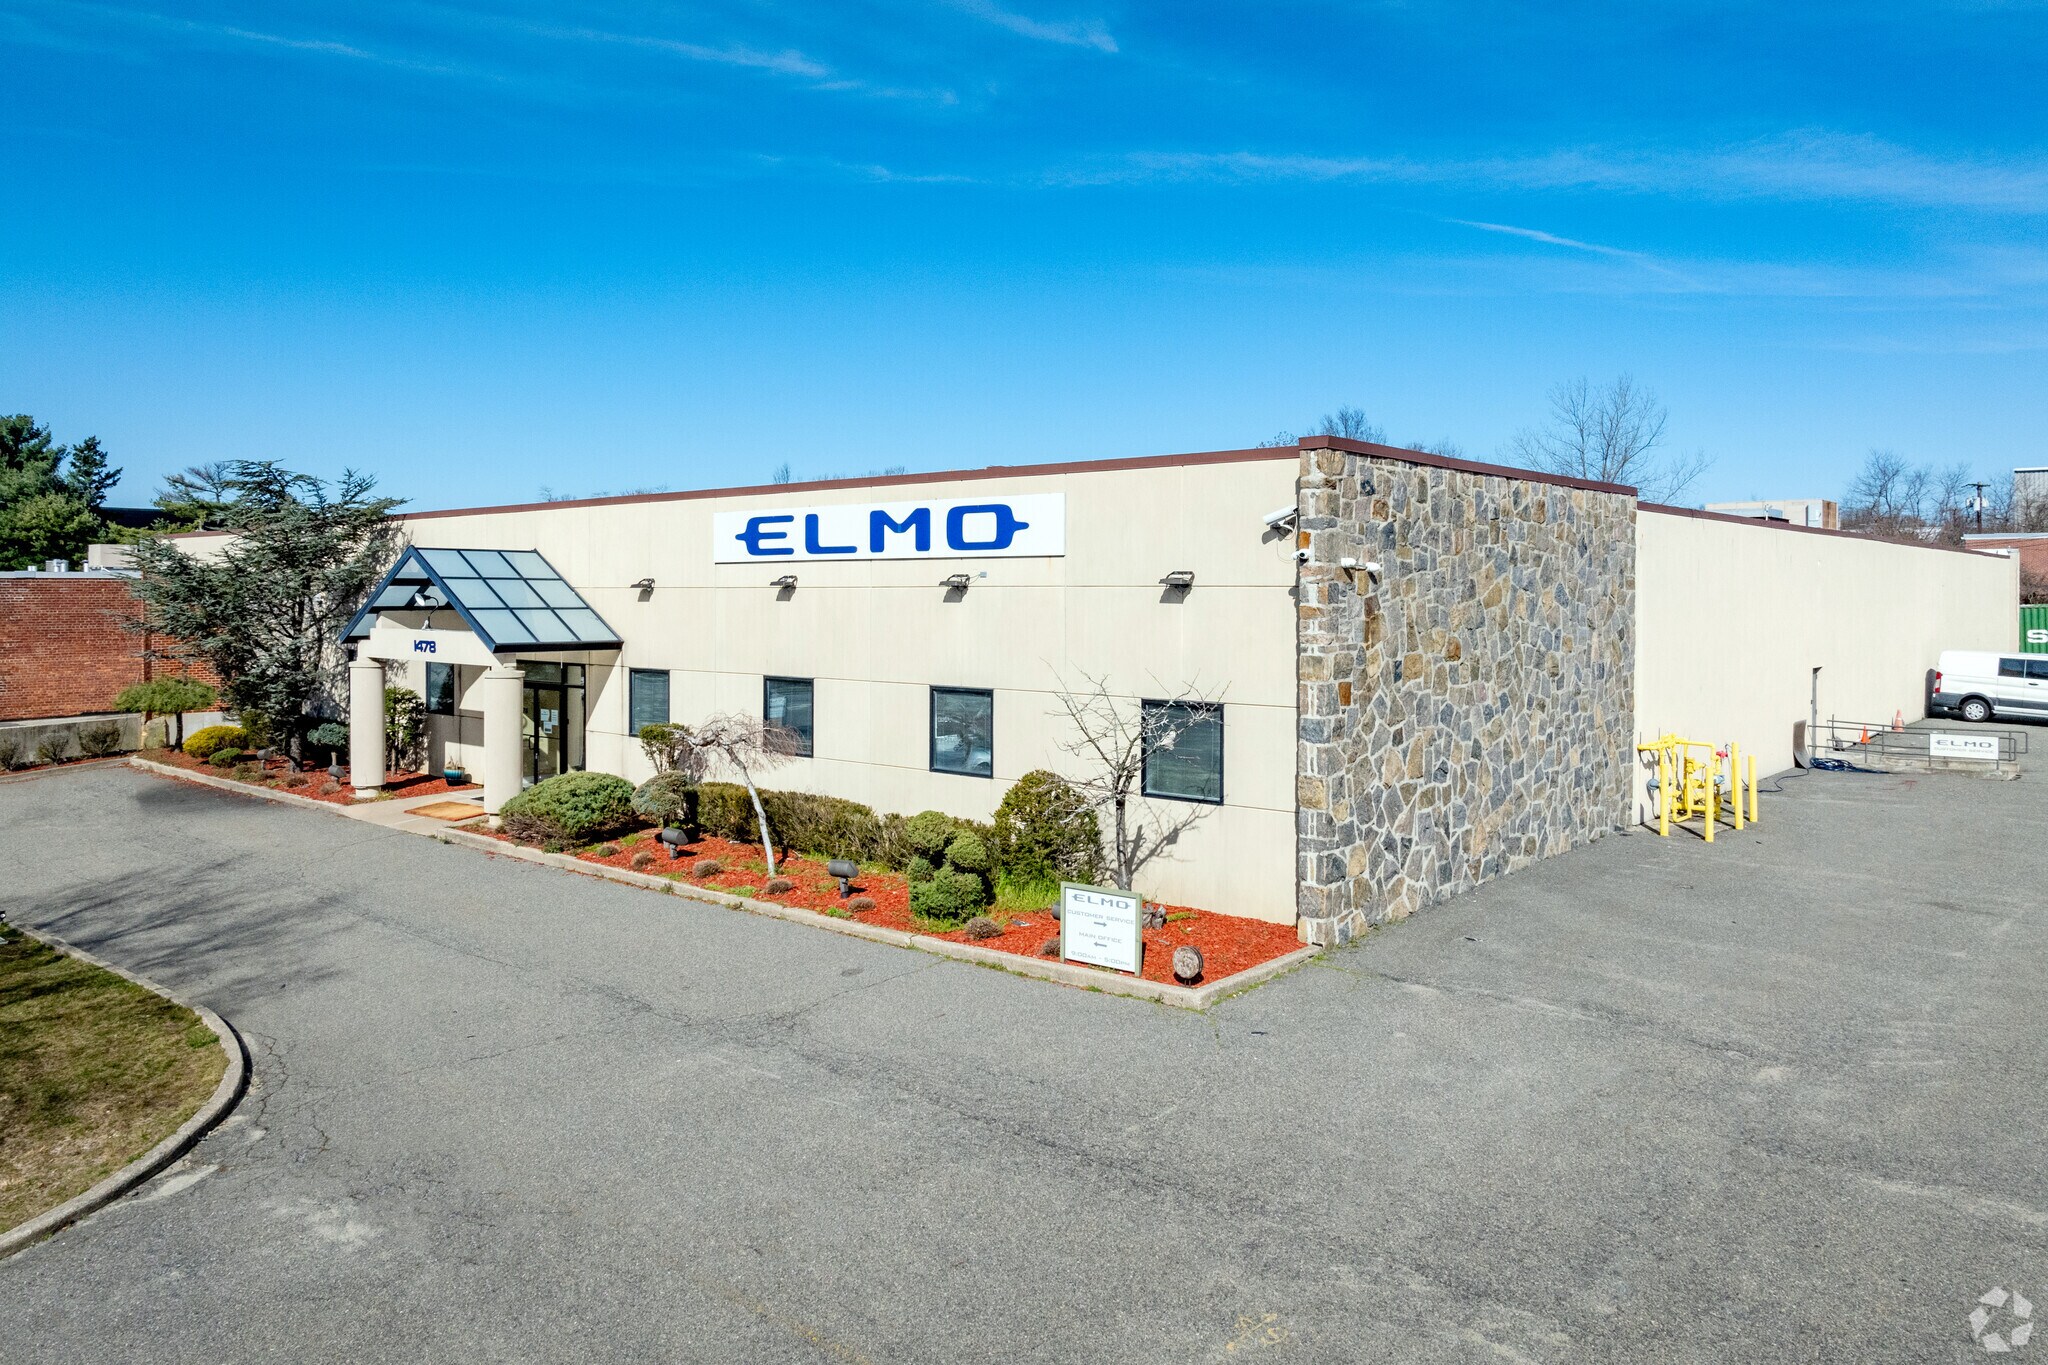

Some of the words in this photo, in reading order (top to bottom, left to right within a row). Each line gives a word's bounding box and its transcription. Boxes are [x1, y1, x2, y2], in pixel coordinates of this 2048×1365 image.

[735, 504, 1030, 556] ELMO
[413, 640, 437, 653] 1478
[1936, 740, 1994, 748] ELMO
[1072, 893, 1131, 909] ELMO
[1067, 909, 1104, 919] CUSTOMER
[1106, 915, 1135, 925] SERVICE
[1078, 931, 1096, 939] MAIN
[1097, 935, 1123, 944] OFFICE
